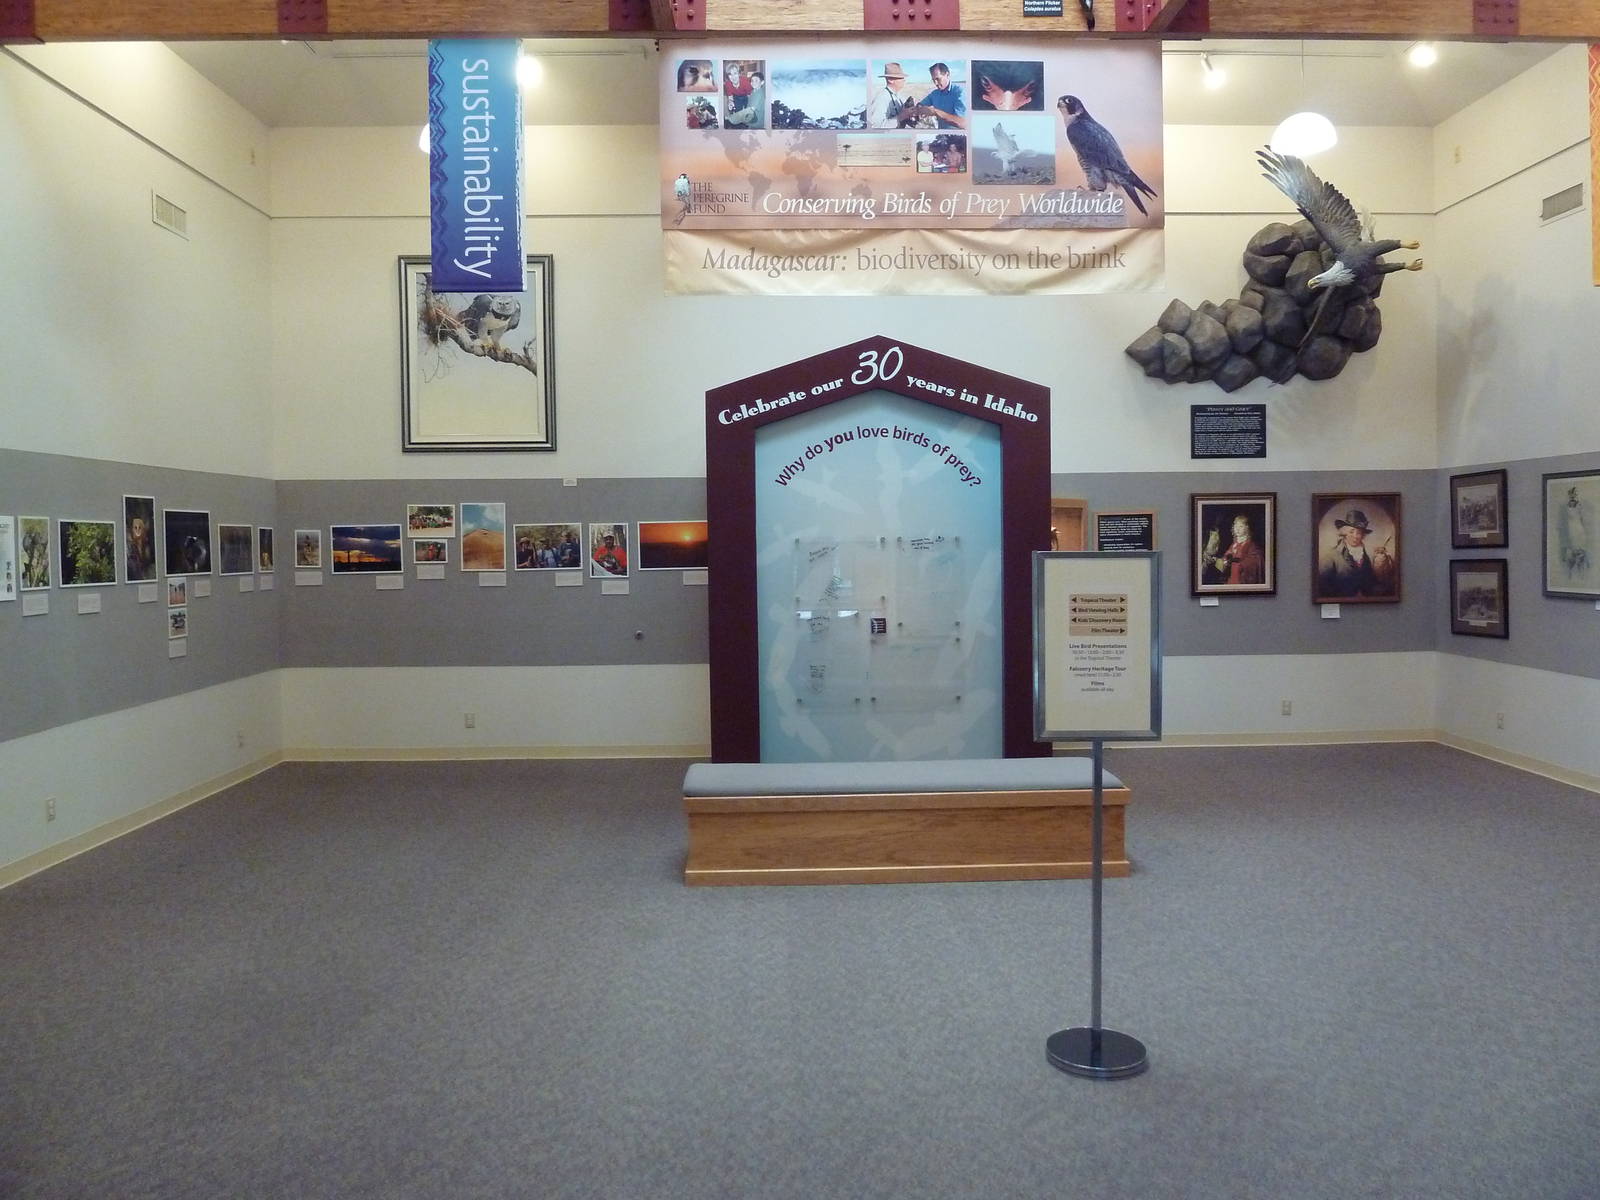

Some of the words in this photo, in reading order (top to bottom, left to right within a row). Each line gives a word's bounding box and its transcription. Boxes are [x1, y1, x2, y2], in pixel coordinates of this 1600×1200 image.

[453, 58, 504, 279] sustainability
[693, 182, 712, 191] THE
[693, 193, 749, 203] PEREGRINE
[693, 204, 726, 214] FUND
[763, 192, 876, 219] Conserving
[883, 193, 931, 214] Birds
[939, 192, 961, 219] of
[966, 193, 1010, 219] Prey
[1019, 192, 1124, 214] Worldwide
[702, 247, 847, 278] Madagascar:
[857, 246, 986, 276] biodiversity
[992, 254, 1021, 269] on
[1027, 248, 1060, 269] the
[1067, 246, 1126, 269] brink
[718, 391, 806, 425] Celebrate
[811, 378, 844, 395] our
[851, 346, 904, 385] 30
[906, 375, 955, 397] years
[960, 388, 979, 405] in
[984, 394, 1038, 423] Idaho
[775, 457, 806, 486] Why
[805, 445, 824, 460] do
[824, 431, 854, 452] you
[856, 426, 889, 439] love
[892, 425, 930, 448] birds
[931, 442, 950, 457] of
[945, 454, 982, 487] prey?
